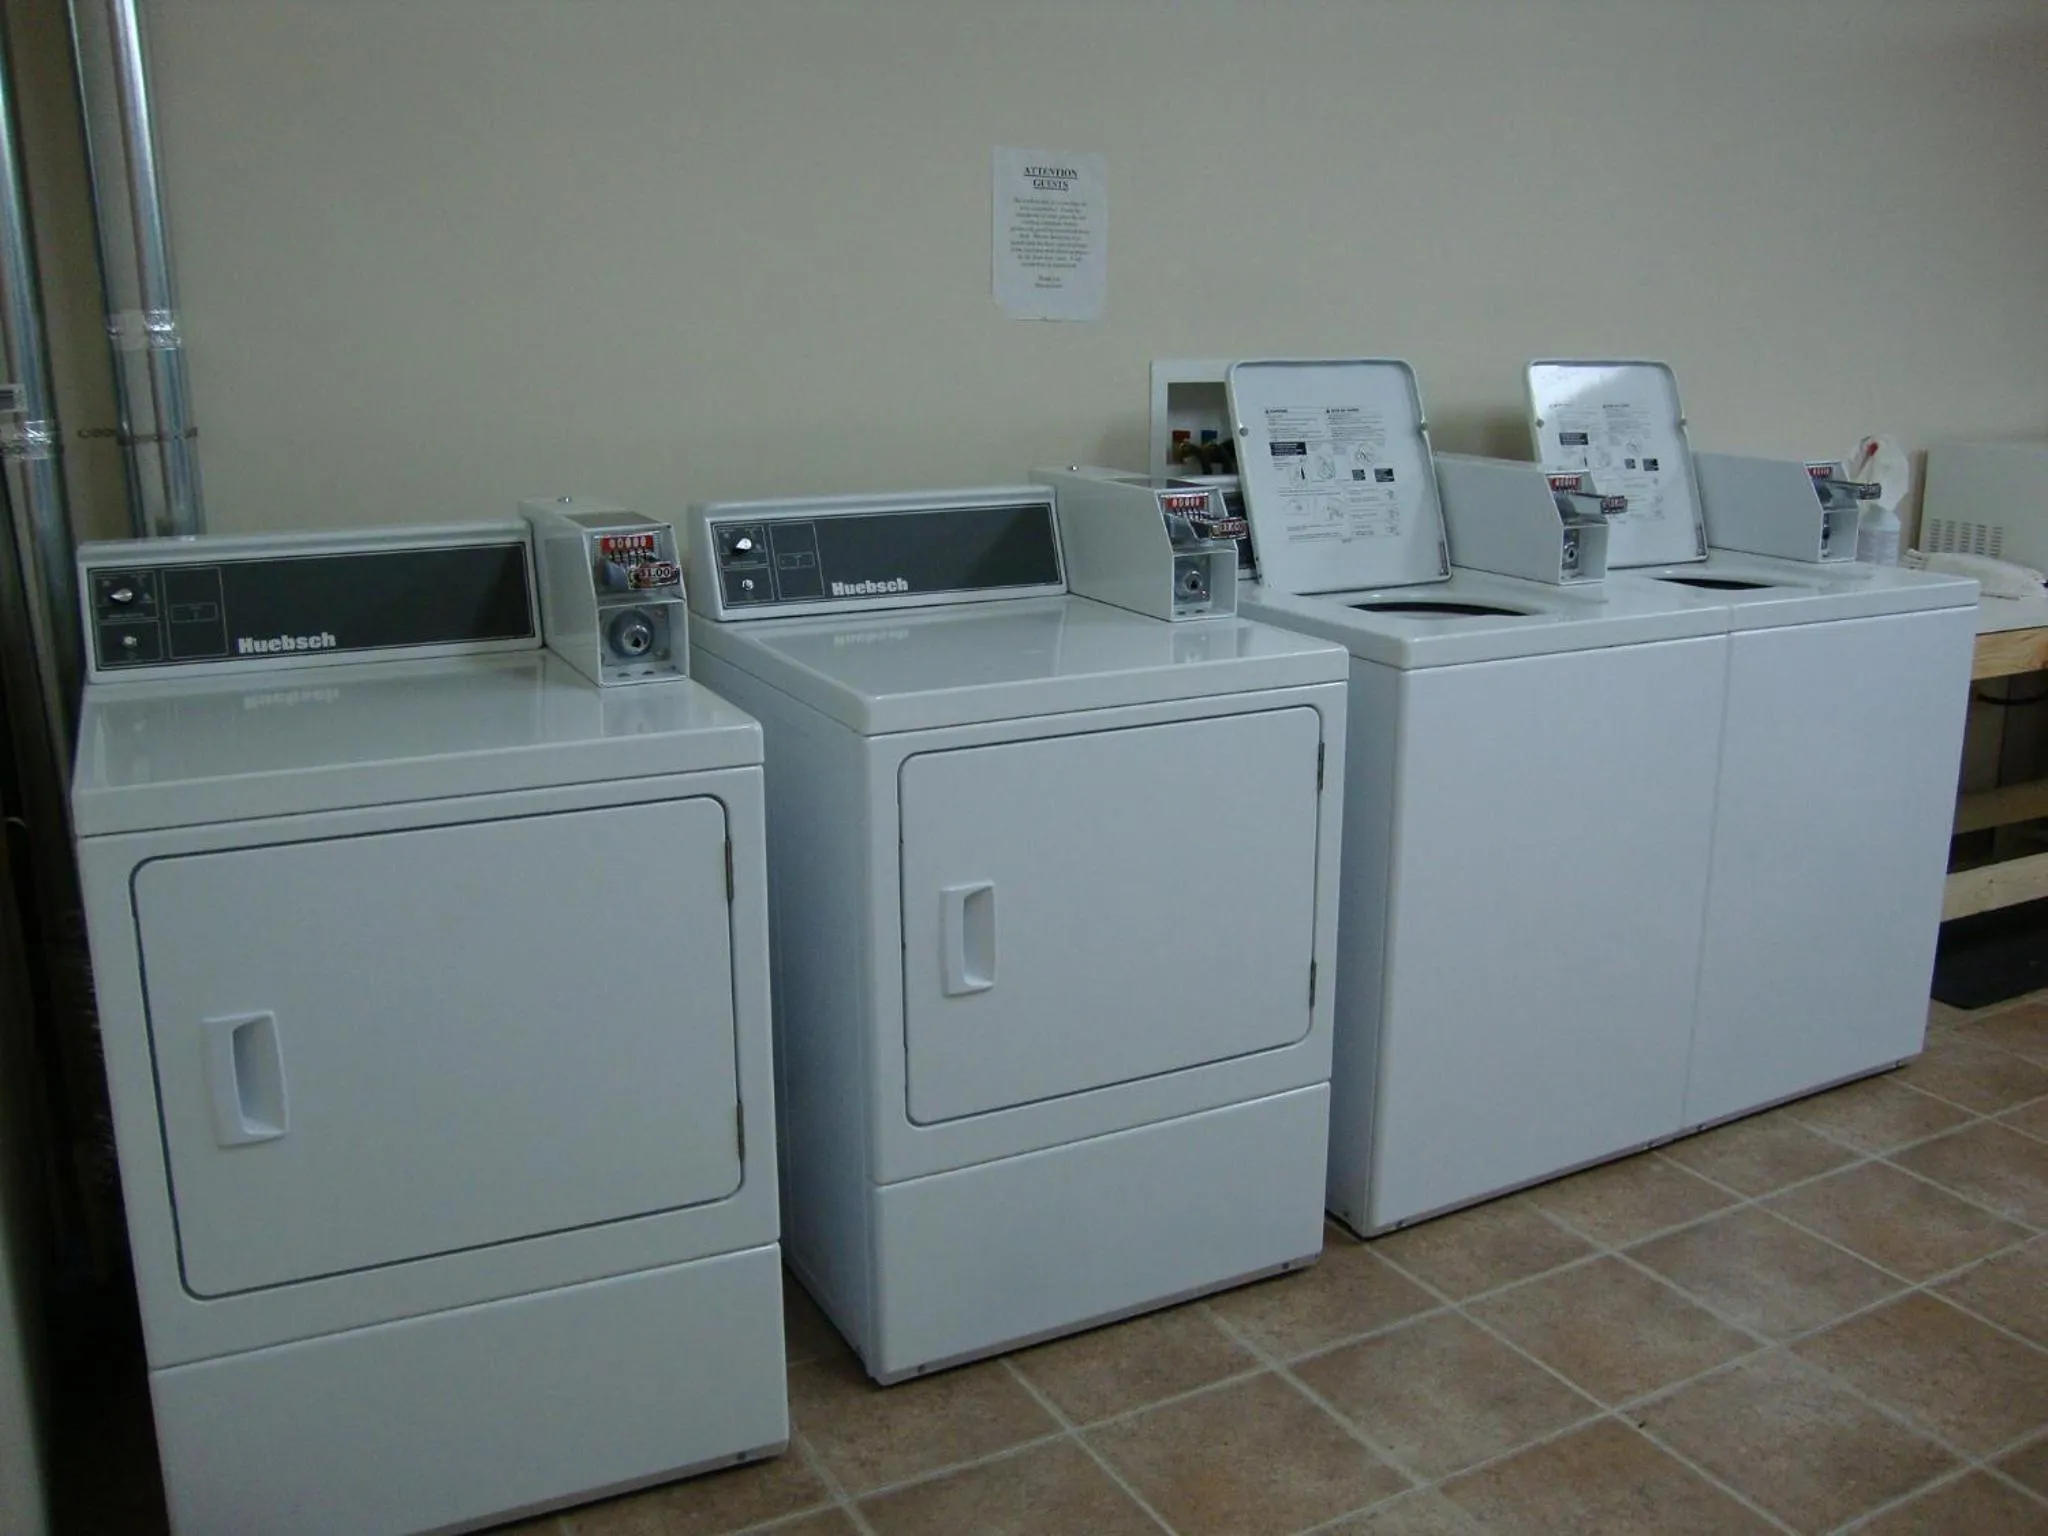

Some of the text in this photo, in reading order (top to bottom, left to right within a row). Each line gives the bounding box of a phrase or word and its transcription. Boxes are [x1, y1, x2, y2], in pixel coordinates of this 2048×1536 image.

[1024, 166, 1078, 179] ATTENTION
[1032, 179, 1069, 191] GUESTS
[831, 577, 909, 596] Huebsch
[238, 631, 336, 654] Huebsch
